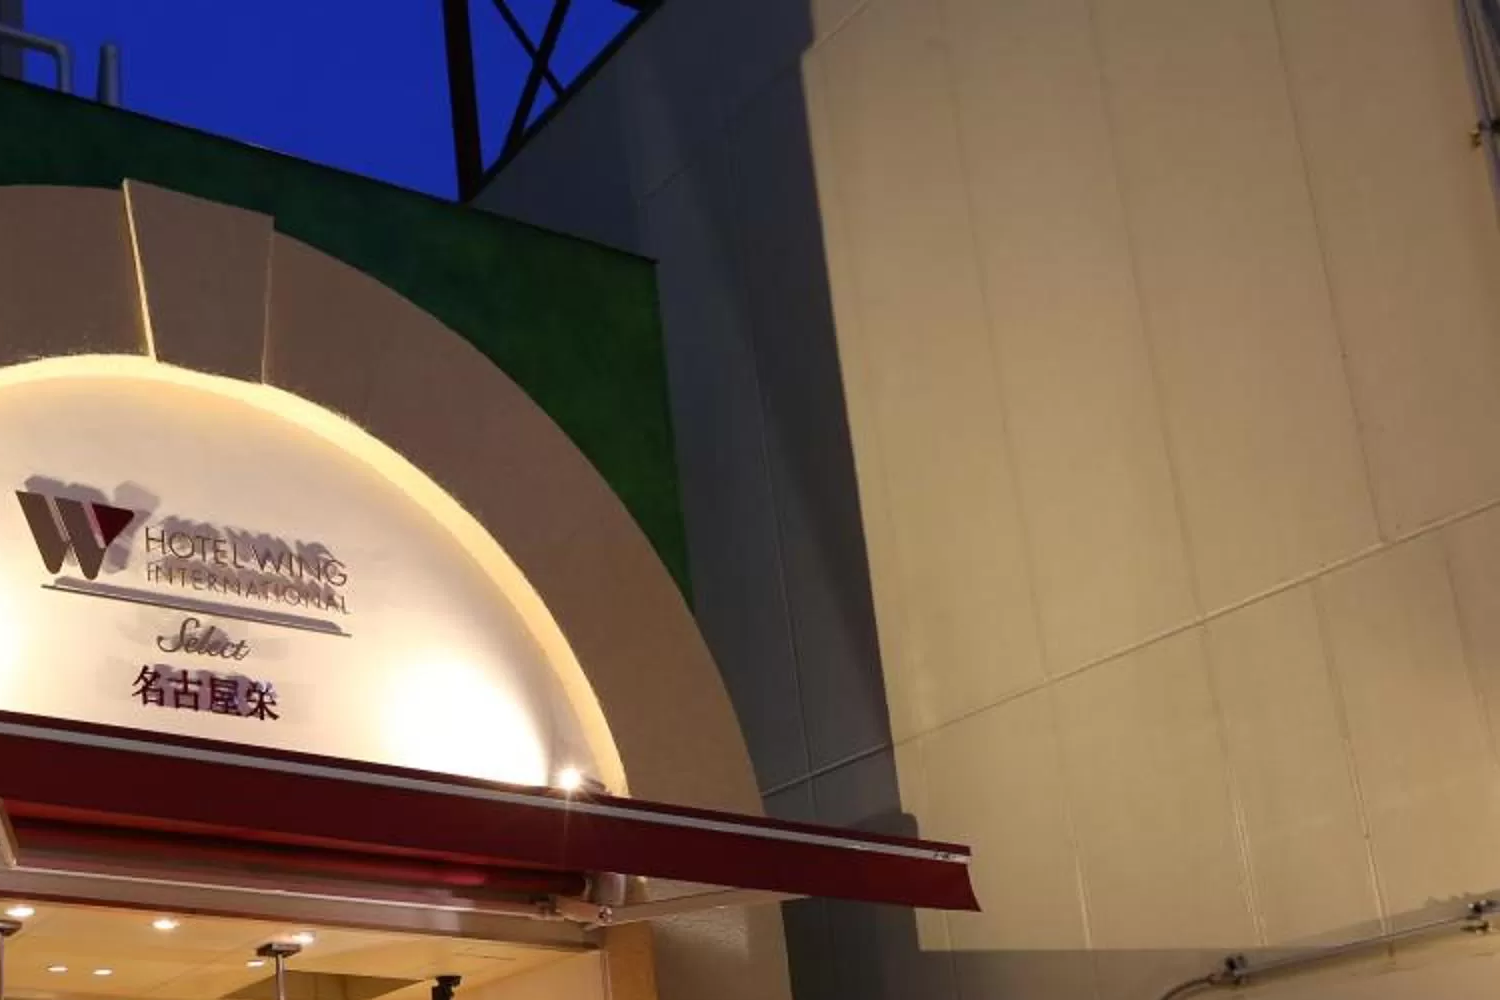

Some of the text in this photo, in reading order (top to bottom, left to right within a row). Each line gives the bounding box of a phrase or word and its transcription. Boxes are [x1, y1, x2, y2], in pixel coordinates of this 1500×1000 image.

[145, 526, 348, 587] HOTEL WING
[147, 560, 351, 614] INTERNATIONAL
[157, 618, 252, 661] Select
[132, 665, 279, 721] 名古屋栄
